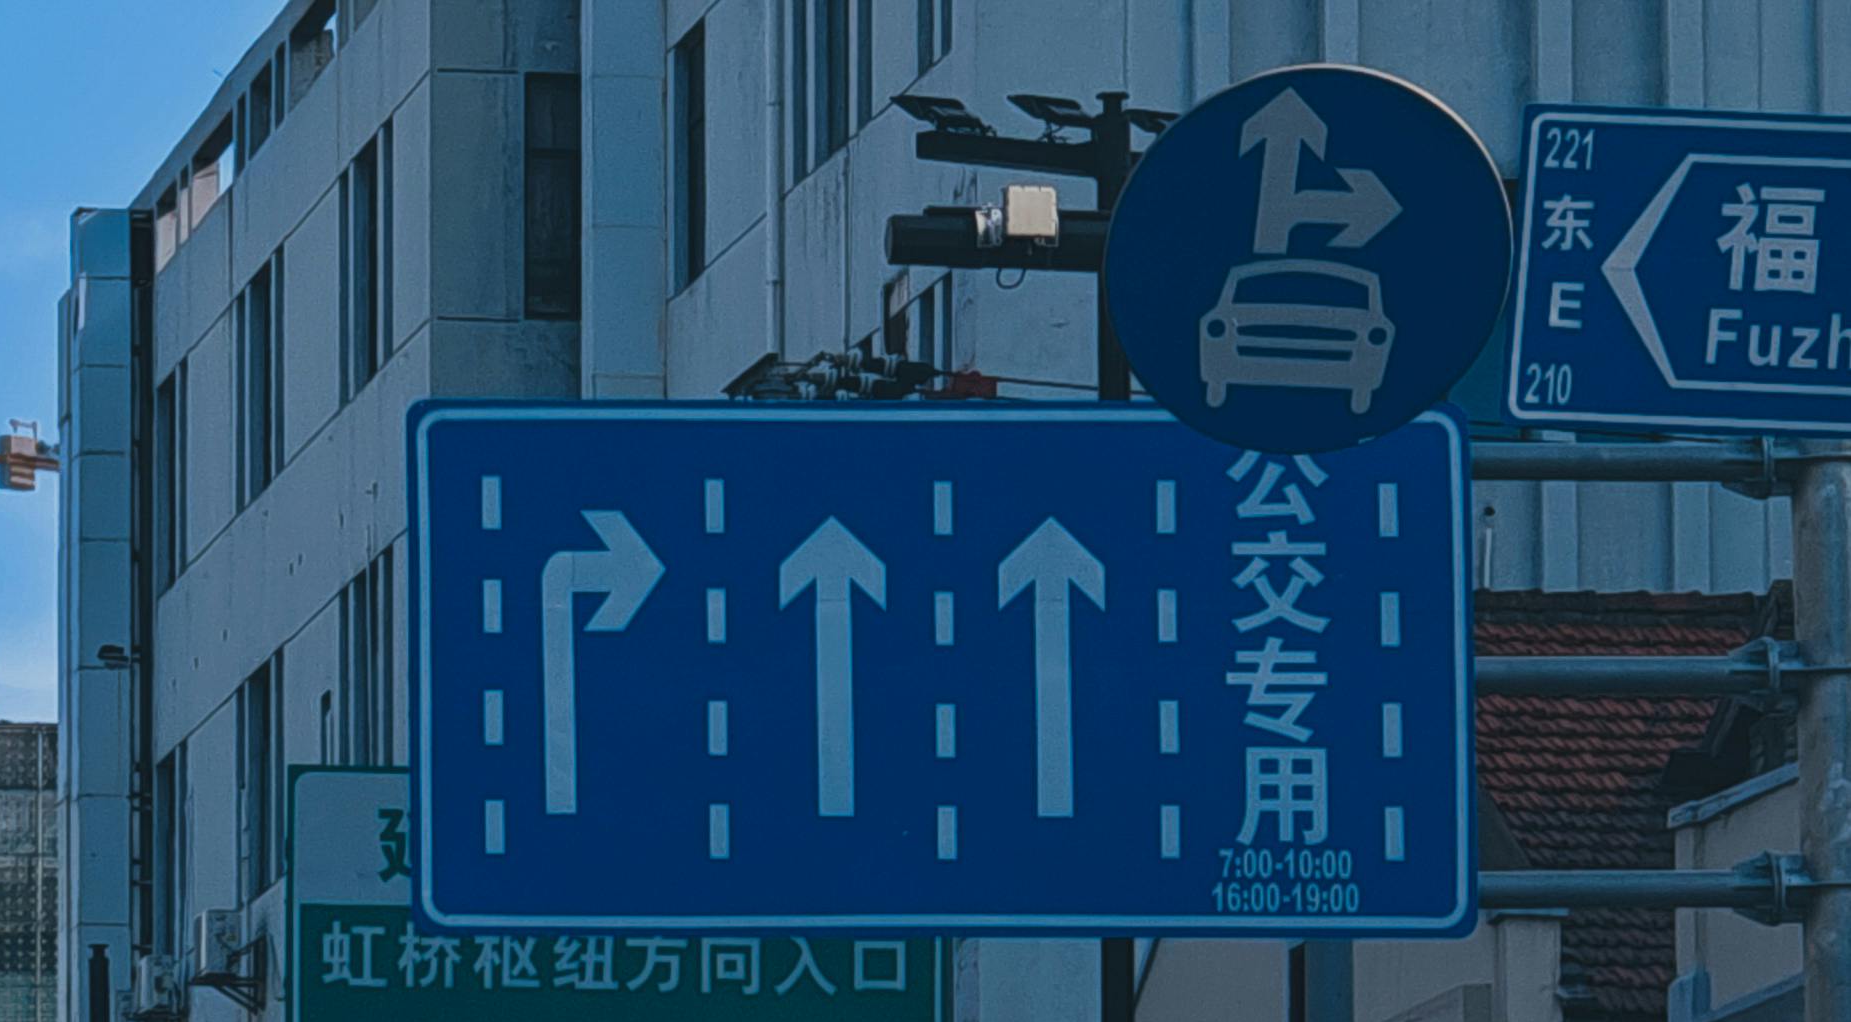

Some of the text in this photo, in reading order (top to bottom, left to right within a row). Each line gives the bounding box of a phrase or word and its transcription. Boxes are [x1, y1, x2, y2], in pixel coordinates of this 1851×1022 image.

[1543, 127, 1595, 171] 221
[1541, 193, 1595, 251] 东
[1716, 182, 1826, 294] 福
[1548, 281, 1585, 329] E
[1523, 362, 1572, 406] 210
[1225, 451, 1332, 846] 公交专用
[1218, 848, 1353, 880] 7:00-10:00
[1211, 882, 1360, 914] 16:00-19:00
[321, 920, 907, 996] 虹桥枢纽方向入口
